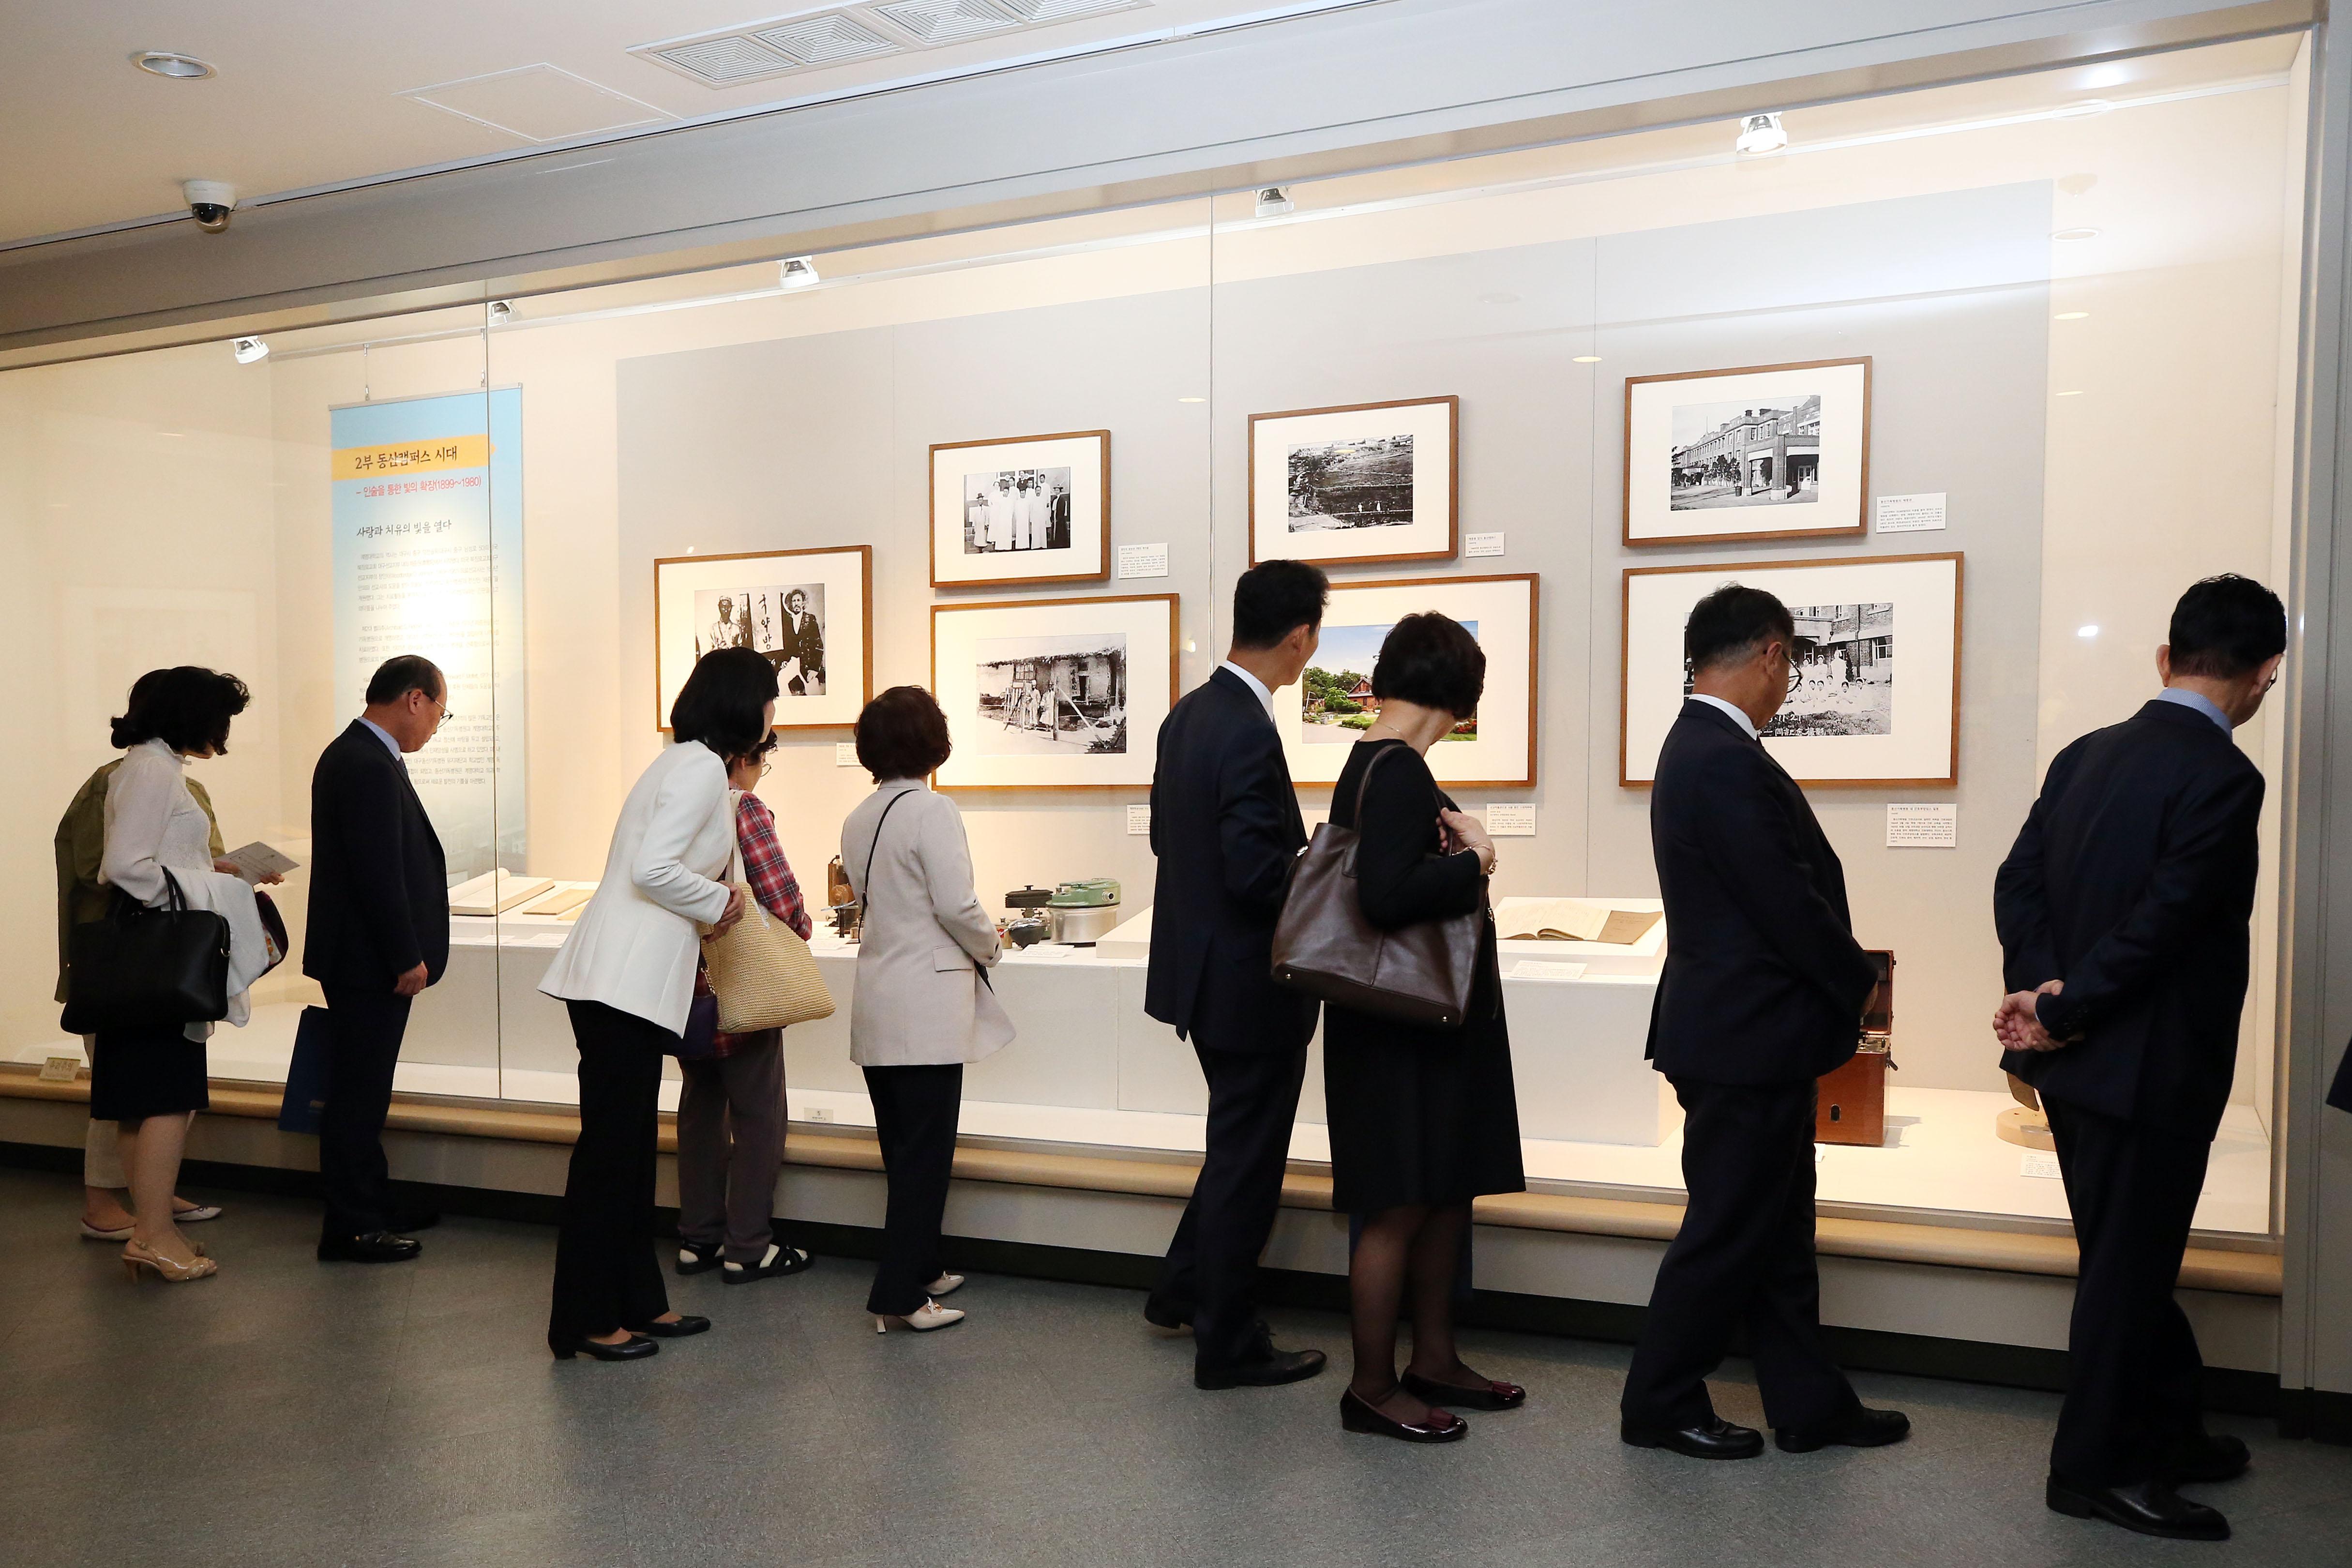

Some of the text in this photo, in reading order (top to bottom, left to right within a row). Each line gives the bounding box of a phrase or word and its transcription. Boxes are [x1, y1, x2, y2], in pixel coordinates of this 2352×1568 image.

[355, 446, 457, 470] 2부 동산캠퍼스 시대
[363, 485, 385, 498] 인술을
[387, 483, 402, 496] 통한
[404, 482, 418, 493] 빛의
[420, 475, 482, 491] 확장(1899~1980)
[357, 519, 452, 538] 사랑과 치유의 빛을 열다
